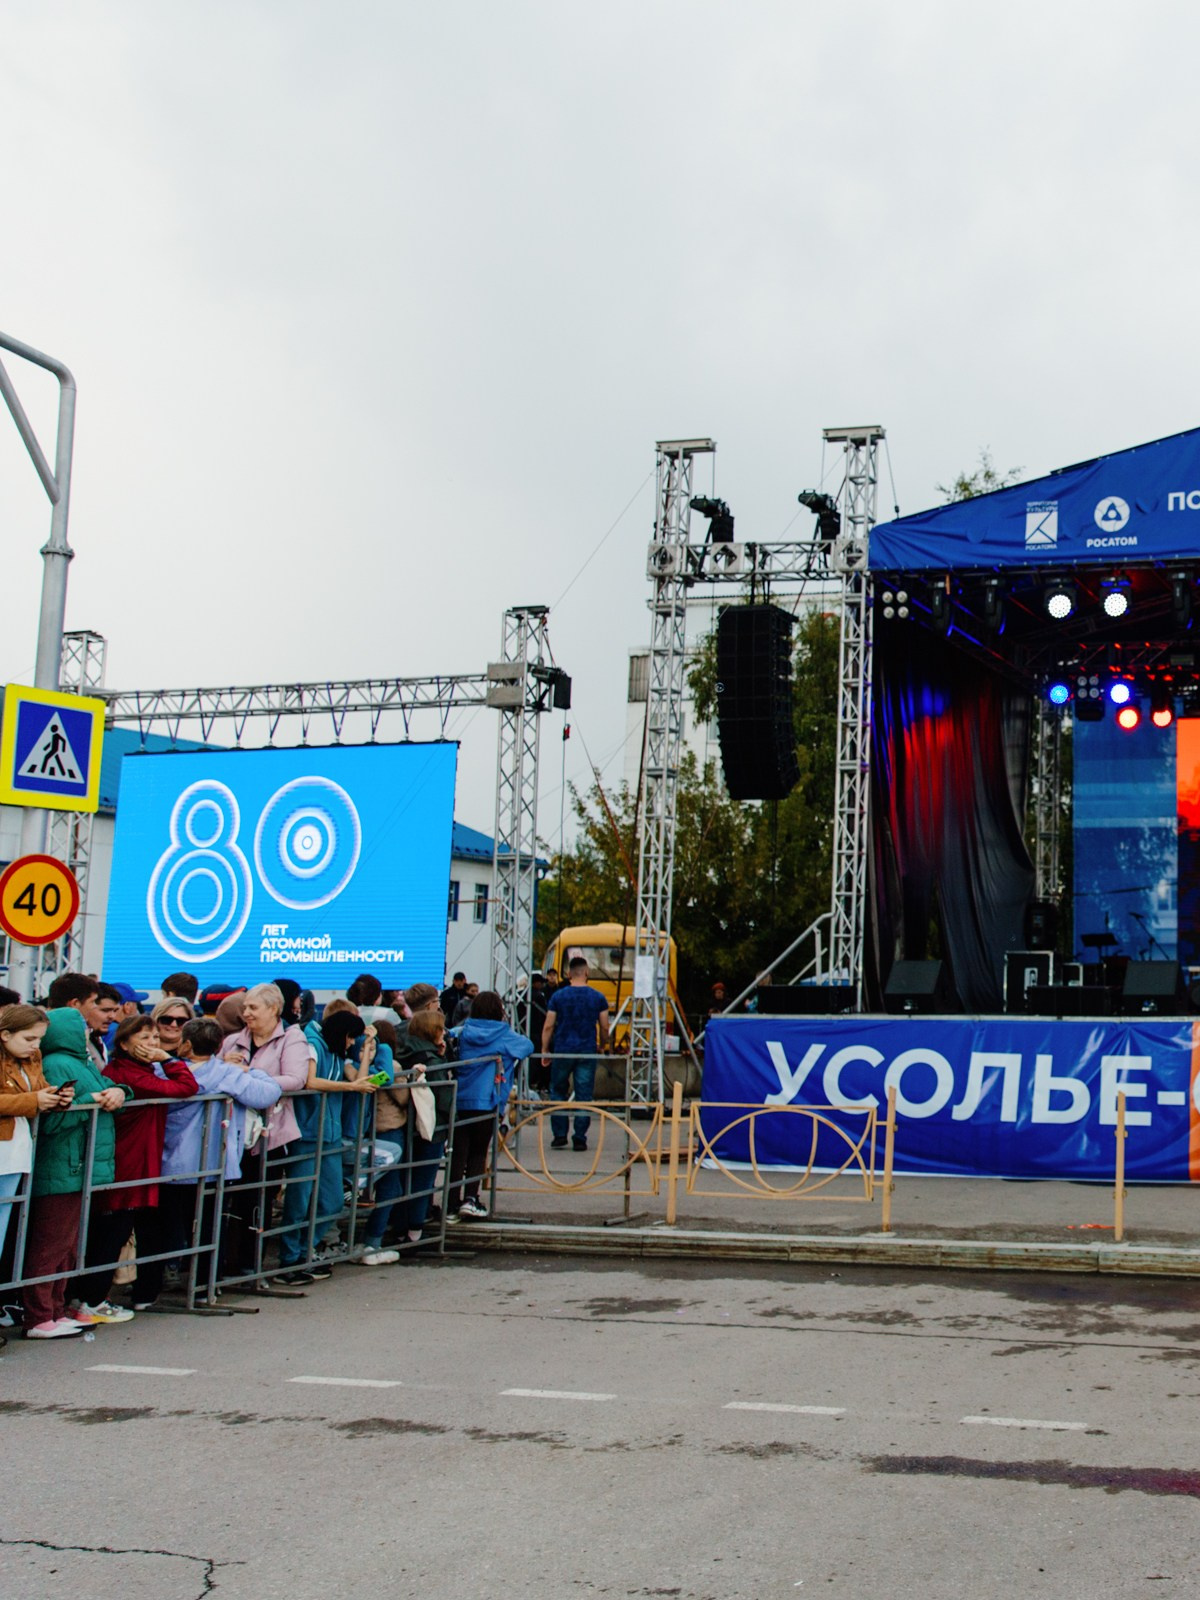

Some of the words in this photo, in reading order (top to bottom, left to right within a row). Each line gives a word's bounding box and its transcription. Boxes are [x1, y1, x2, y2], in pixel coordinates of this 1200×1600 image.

[1086, 537, 1138, 548] РОСАТОМ
[147, 775, 362, 963] 80
[13, 883, 61, 917] 40
[261, 924, 288, 936] ЛЕТ
[260, 934, 331, 949] АТОМНОЙ
[260, 951, 404, 962] ПРОМЫШЛЕННОСТИ
